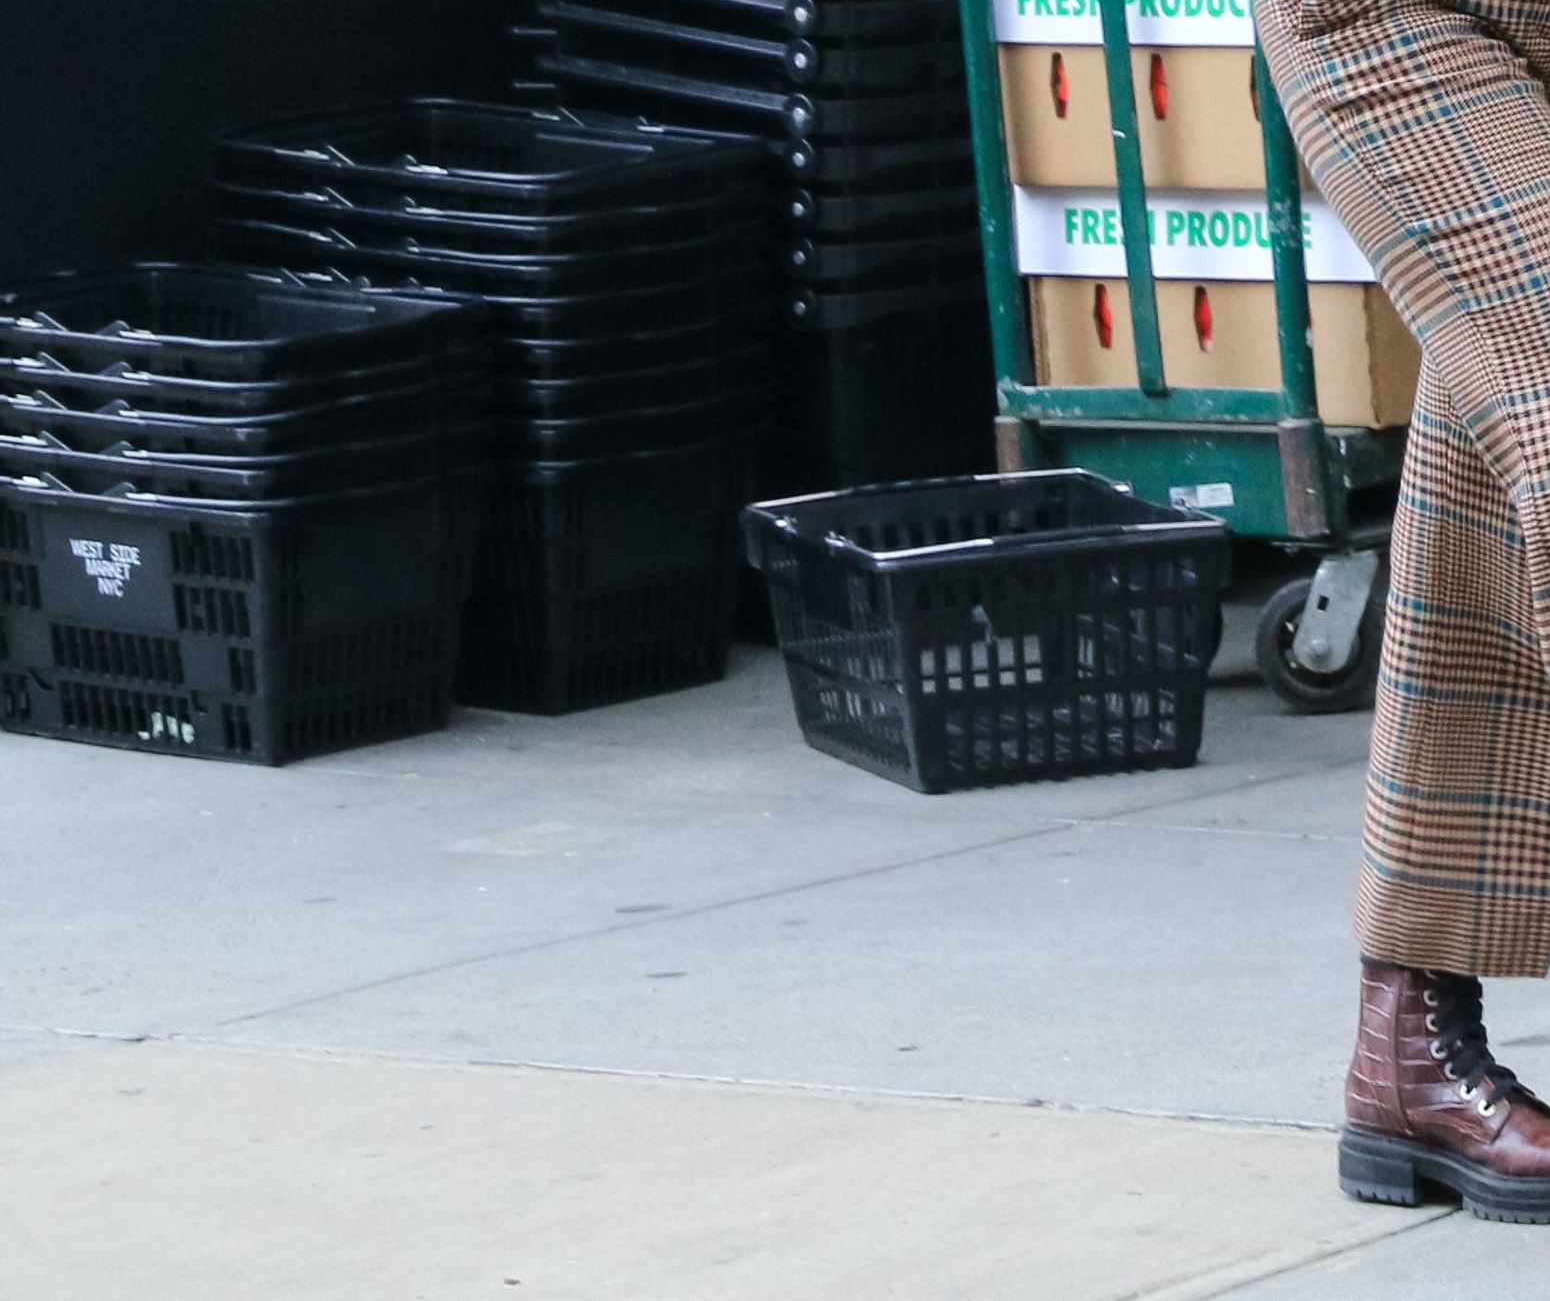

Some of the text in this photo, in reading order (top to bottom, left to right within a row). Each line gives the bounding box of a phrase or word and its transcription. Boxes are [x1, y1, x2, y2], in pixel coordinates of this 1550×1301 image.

[69, 538, 142, 566] WEST SIDE
[85, 558, 131, 580] MARKET
[97, 577, 125, 598] NYC
